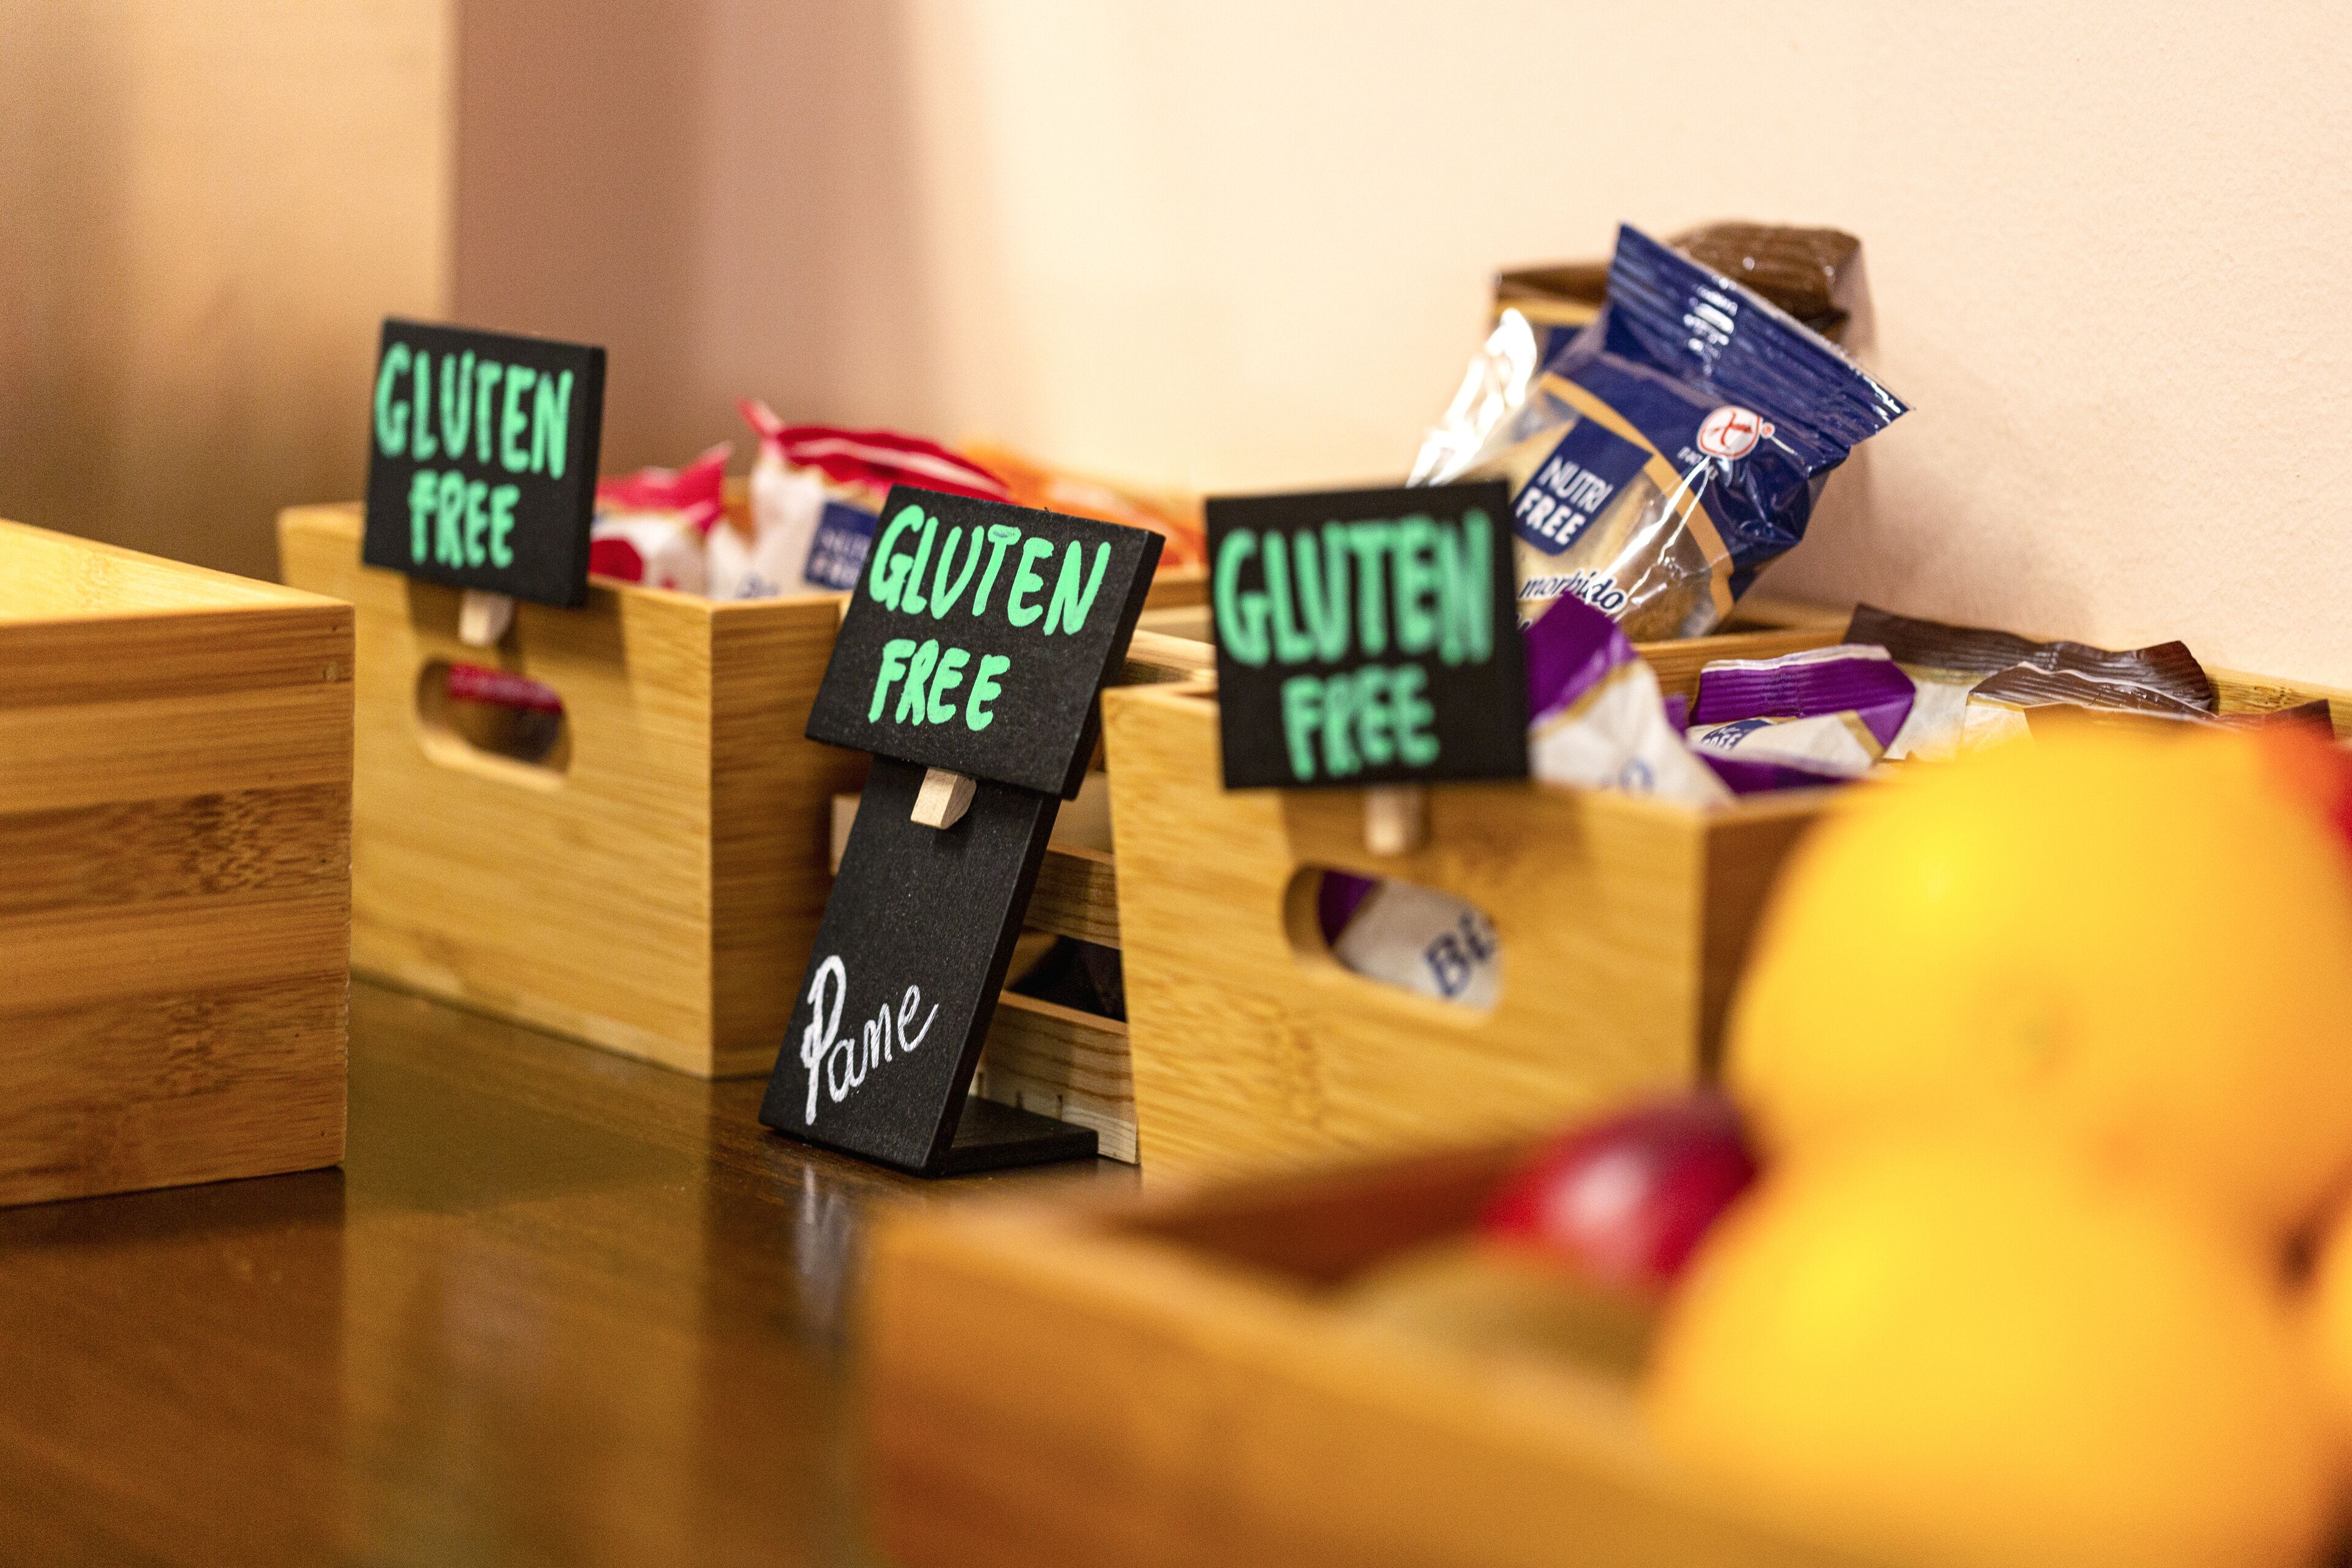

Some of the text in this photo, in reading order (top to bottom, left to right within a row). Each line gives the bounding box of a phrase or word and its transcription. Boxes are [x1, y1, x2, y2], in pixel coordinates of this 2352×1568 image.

[375, 341, 575, 480] GLUTEN
[409, 469, 521, 570] FREE
[1515, 486, 1587, 545] FREE
[1537, 454, 1613, 513] NUTRI
[869, 504, 1111, 636] GLUTEN
[1214, 507, 1494, 669] GLUTEN
[1518, 570, 1626, 610] morbido
[867, 638, 1011, 732] FREE
[1280, 663, 1441, 783] FREE
[800, 955, 939, 1126] Pane
